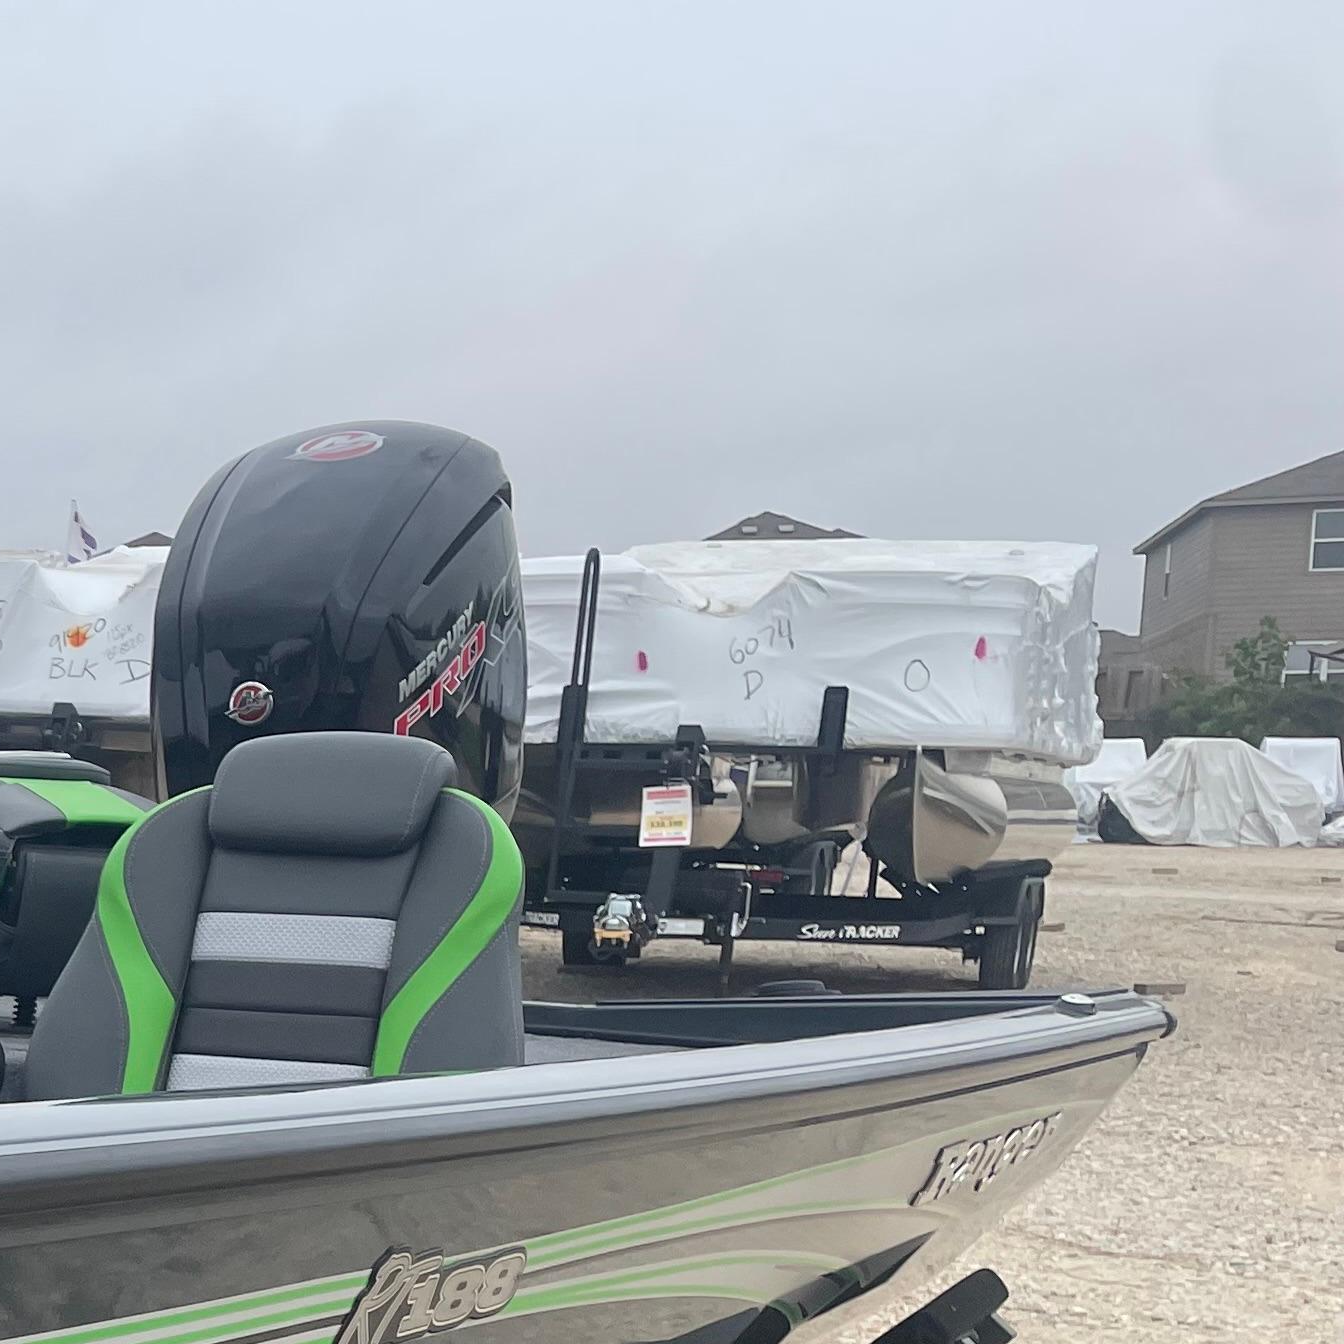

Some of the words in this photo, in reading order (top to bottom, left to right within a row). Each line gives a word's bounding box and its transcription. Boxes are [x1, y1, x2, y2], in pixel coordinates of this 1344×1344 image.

[48, 656, 99, 681] BLK
[394, 620, 486, 737] PRO
[398, 600, 474, 704] MERCURY
[729, 618, 795, 665] 6074
